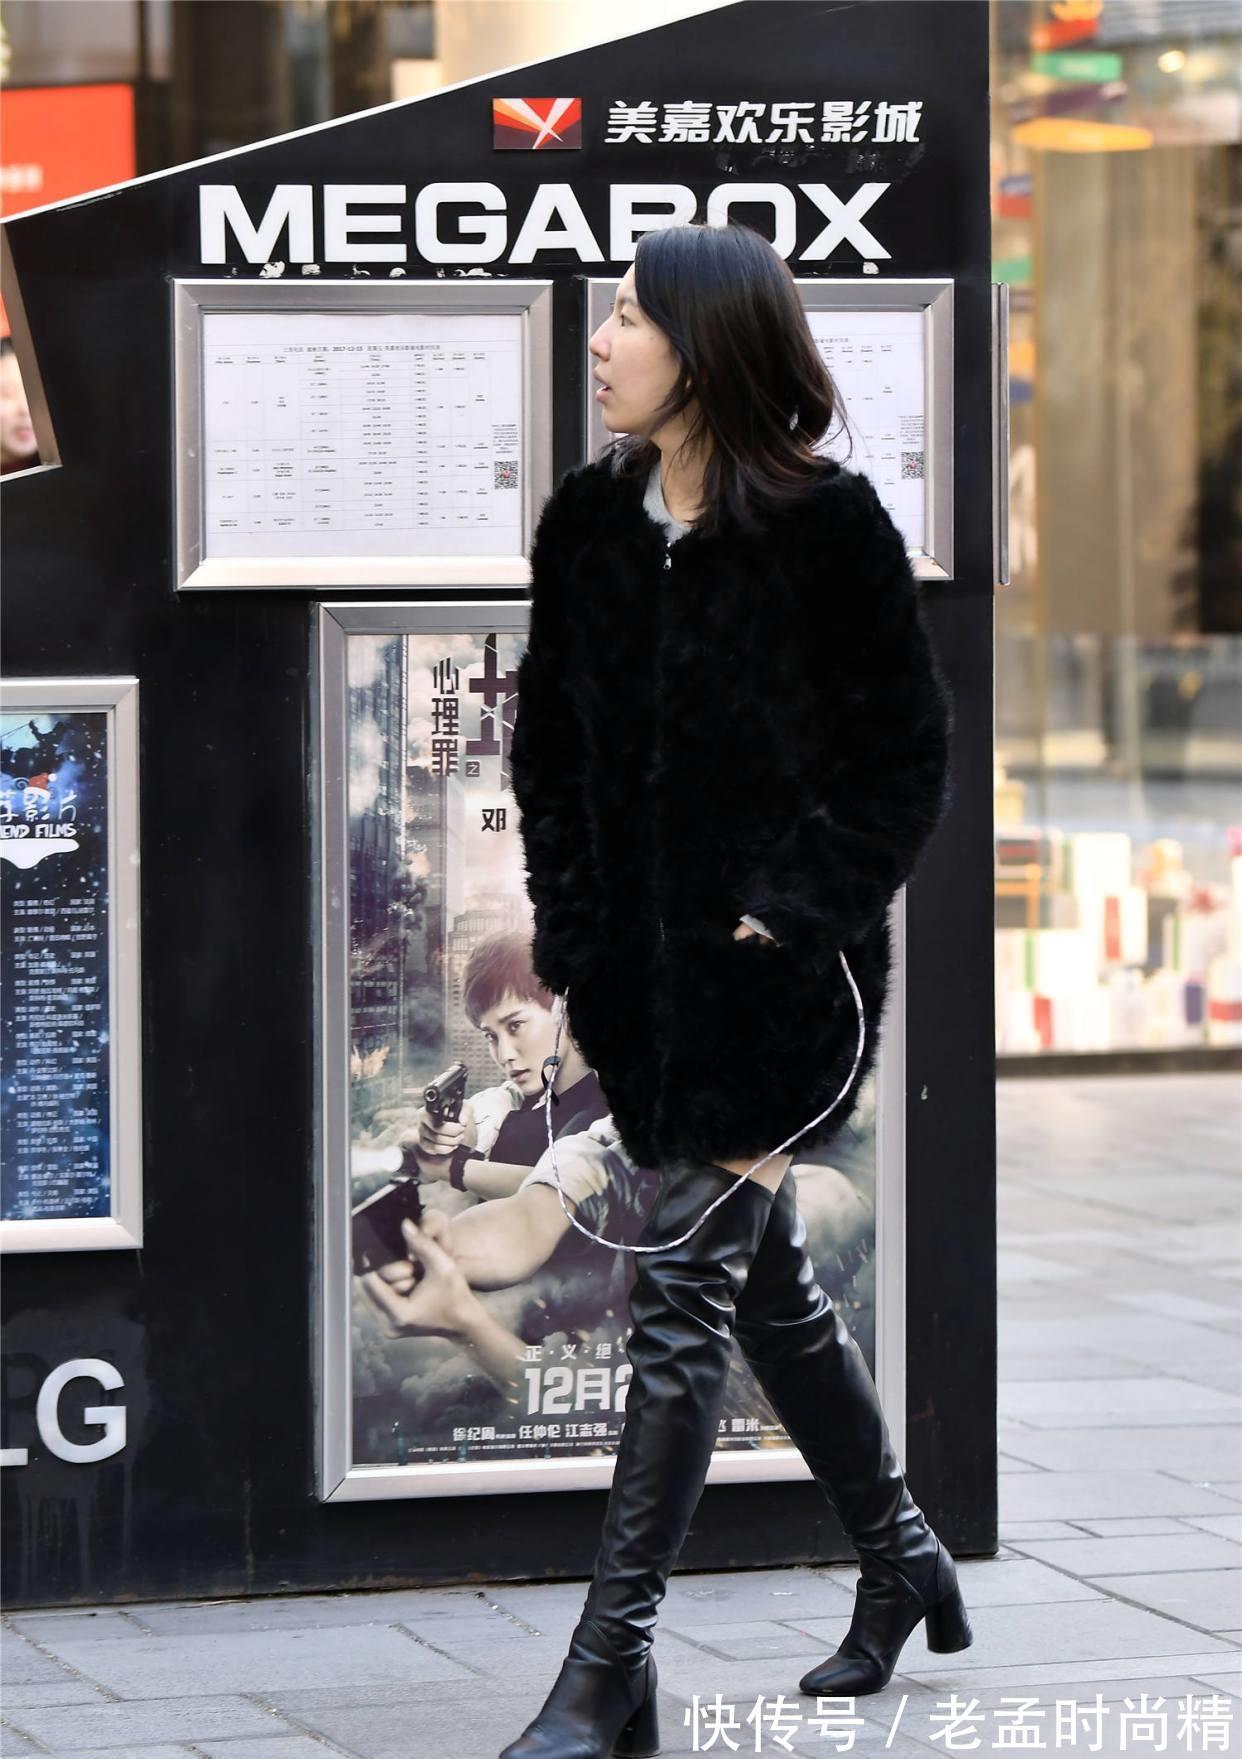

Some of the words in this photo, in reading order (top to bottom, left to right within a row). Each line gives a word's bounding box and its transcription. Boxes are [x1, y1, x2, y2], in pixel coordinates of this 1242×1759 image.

[604, 100, 923, 144] 美嘉欢乐影城
[200, 182, 892, 265] MEGABOX
[432, 656, 459, 777] 心理罪
[35, 823, 77, 838] FILMS
[481, 808, 506, 832] 邓
